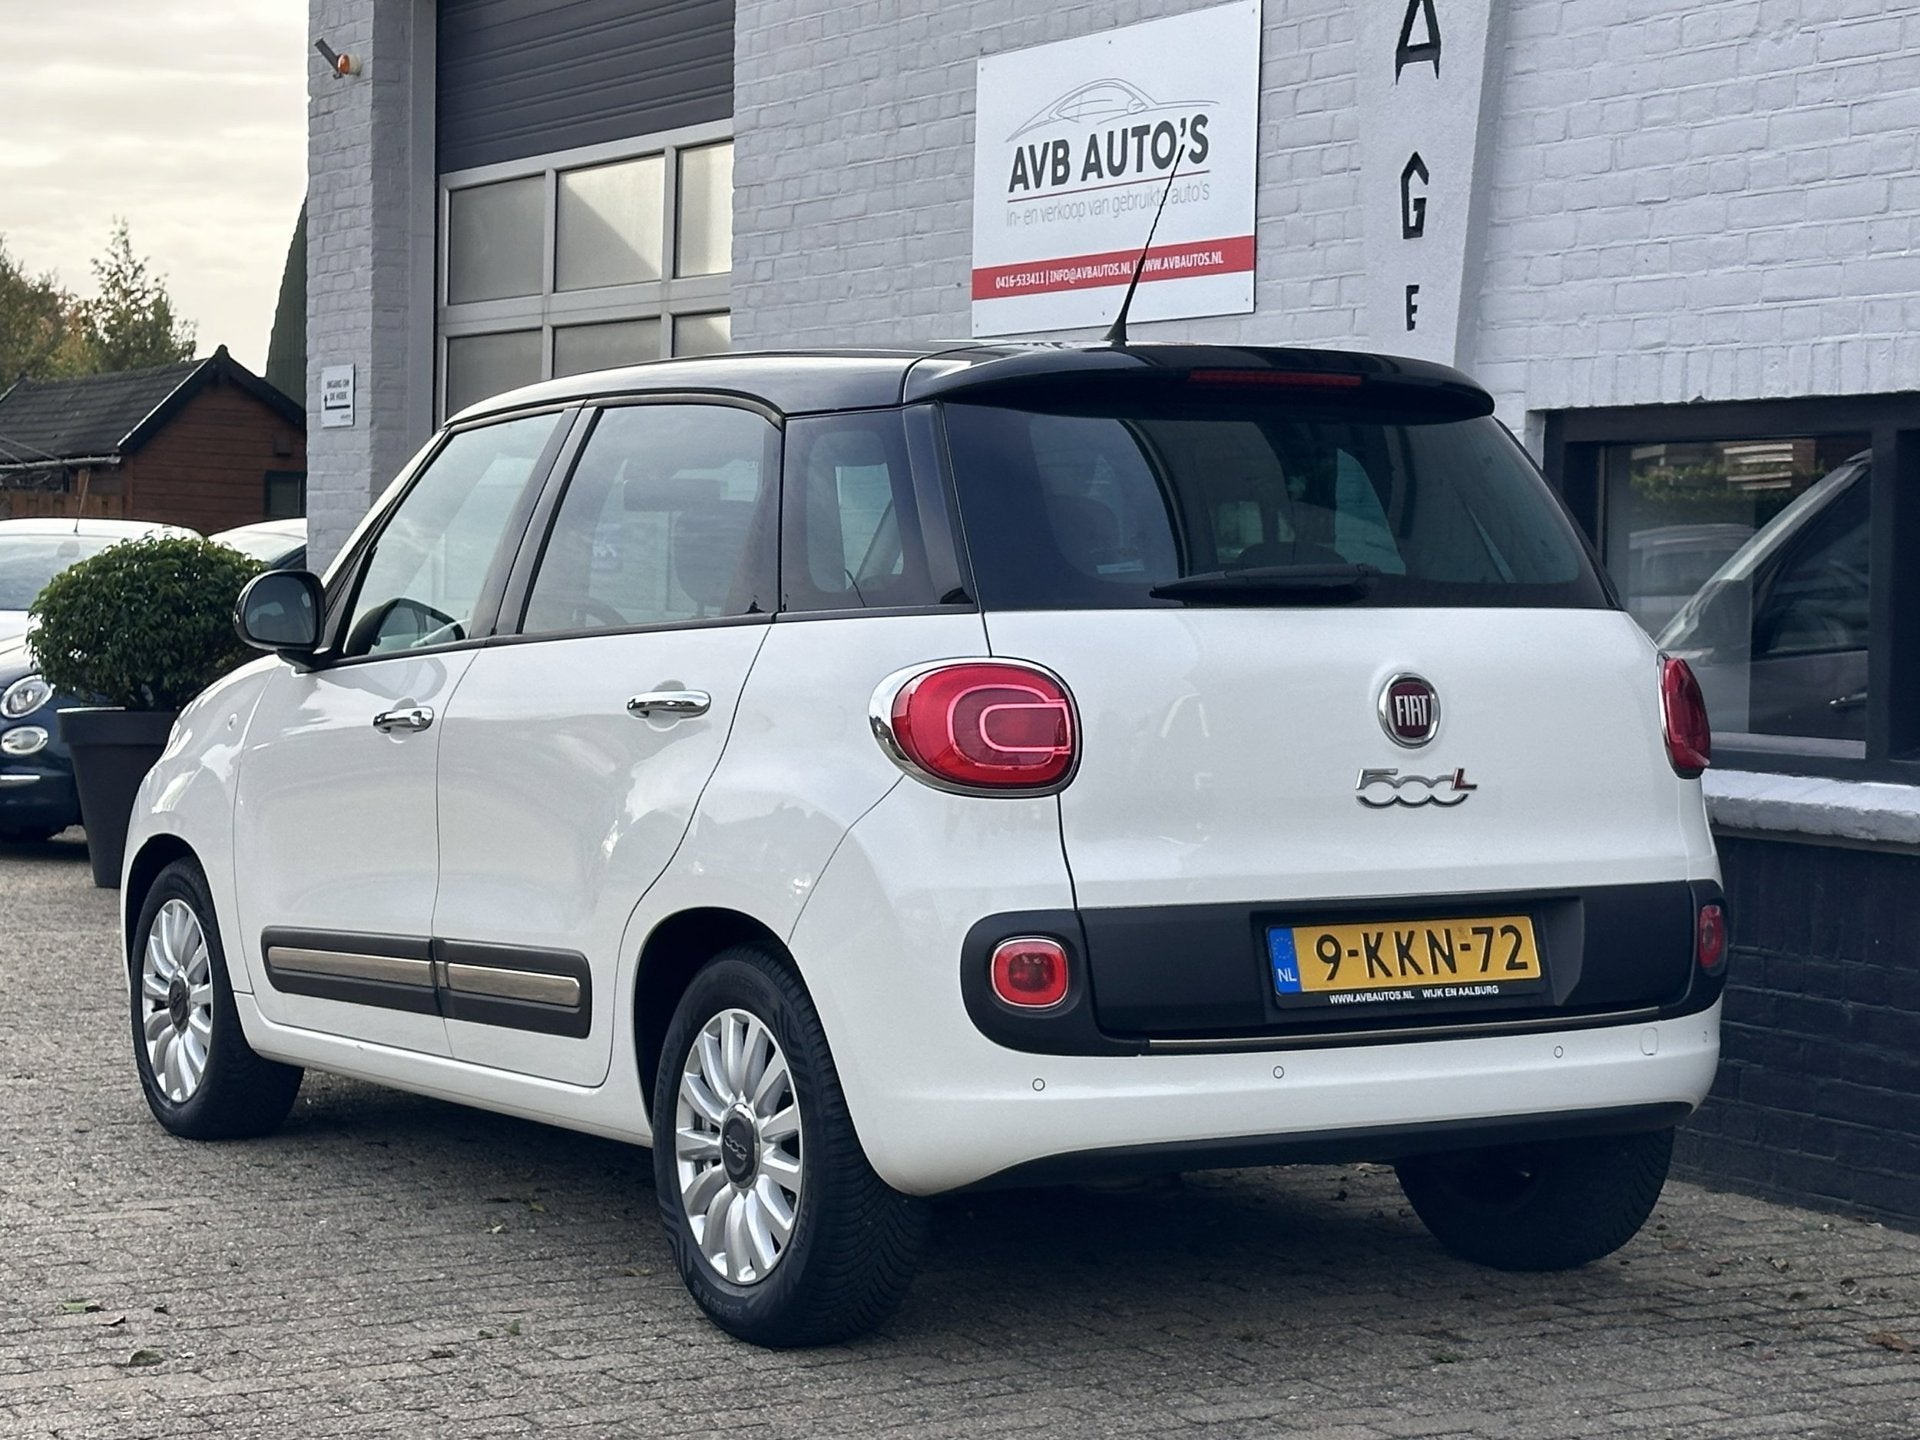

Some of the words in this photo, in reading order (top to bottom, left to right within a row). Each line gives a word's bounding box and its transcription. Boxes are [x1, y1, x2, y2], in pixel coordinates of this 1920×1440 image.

[1008, 138, 1071, 193] AVB
[1080, 113, 1209, 182] AUTO'S
[1023, 208, 1038, 226] en
[1041, 202, 1086, 223] verkoop
[1089, 197, 1110, 216] van
[1171, 182, 1211, 206] auto's
[995, 271, 1045, 289] 0416-533411
[1049, 262, 1132, 284] INFO@AVBAUTOS.NL
[1394, 694, 1428, 727] FIAT
[1355, 767, 1478, 809] 500L
[1277, 967, 1297, 982] NL
[1315, 924, 1529, 981] 9-KKN-72
[1329, 989, 1415, 1005] WWW.AVBAUTOS.NL
[1422, 987, 1444, 999] WIJK
[1445, 986, 1457, 997] EN
[1458, 984, 1499, 996] AALBURG
